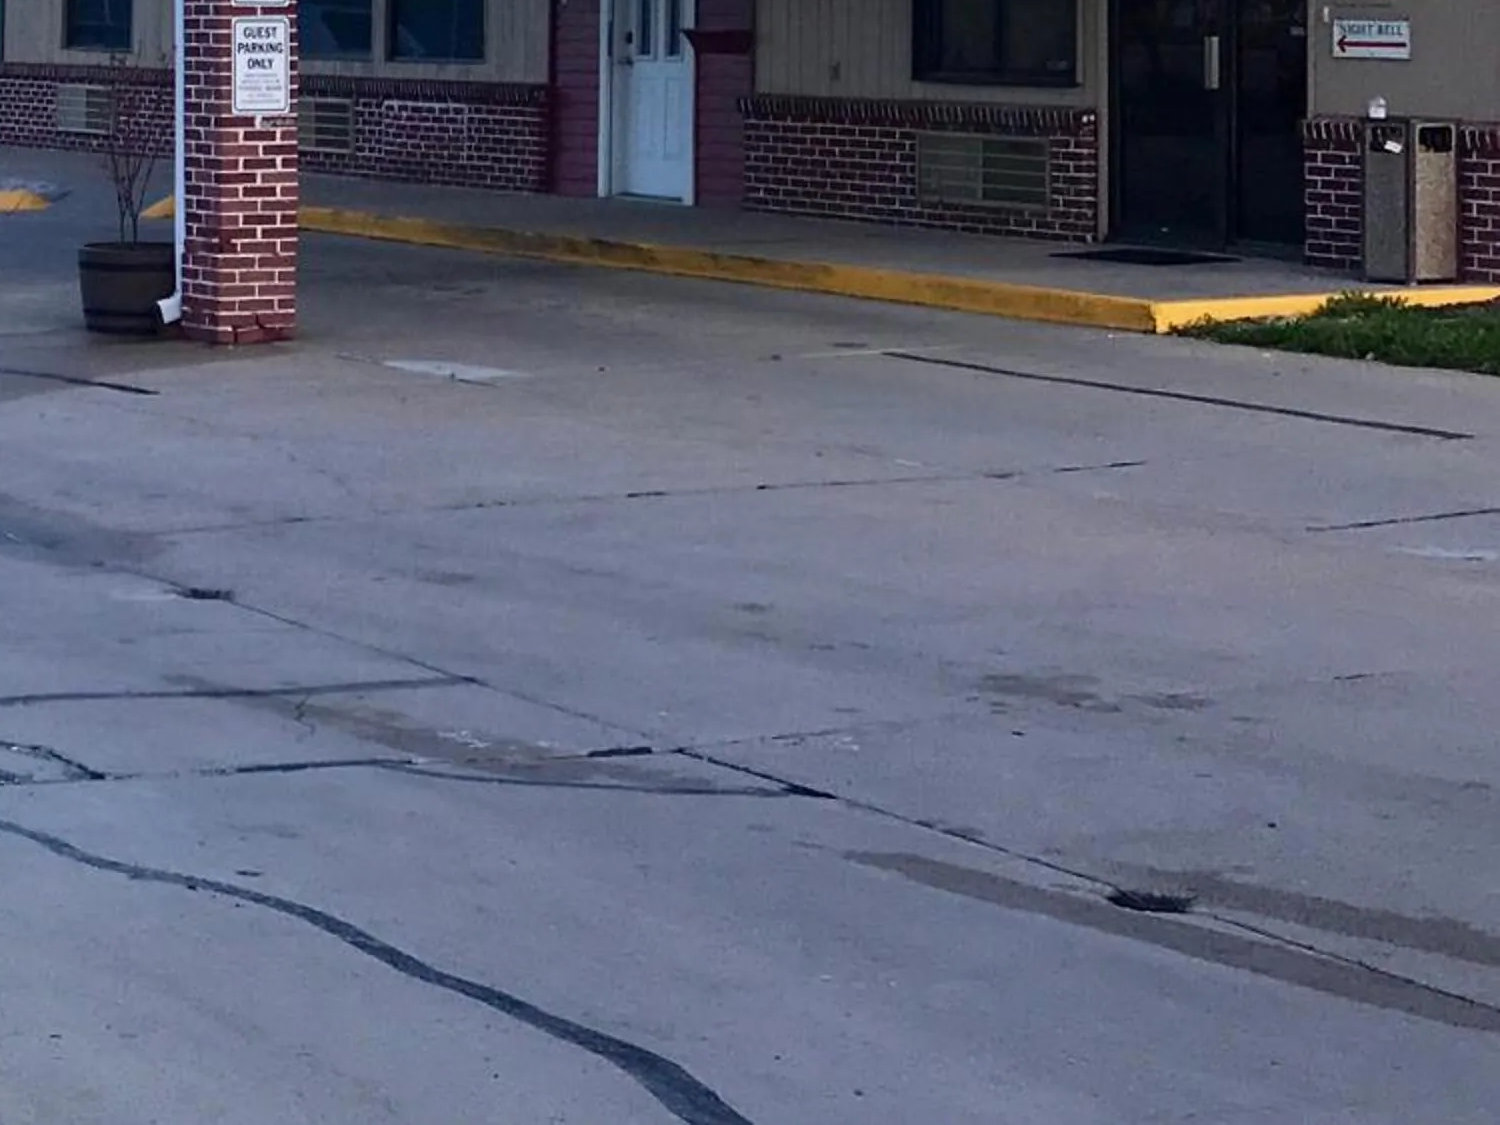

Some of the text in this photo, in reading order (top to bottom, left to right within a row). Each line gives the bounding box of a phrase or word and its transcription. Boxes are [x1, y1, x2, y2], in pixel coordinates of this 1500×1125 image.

[243, 26, 278, 40] GUEST
[237, 42, 284, 55] PARKING
[247, 58, 274, 70] ONLY
